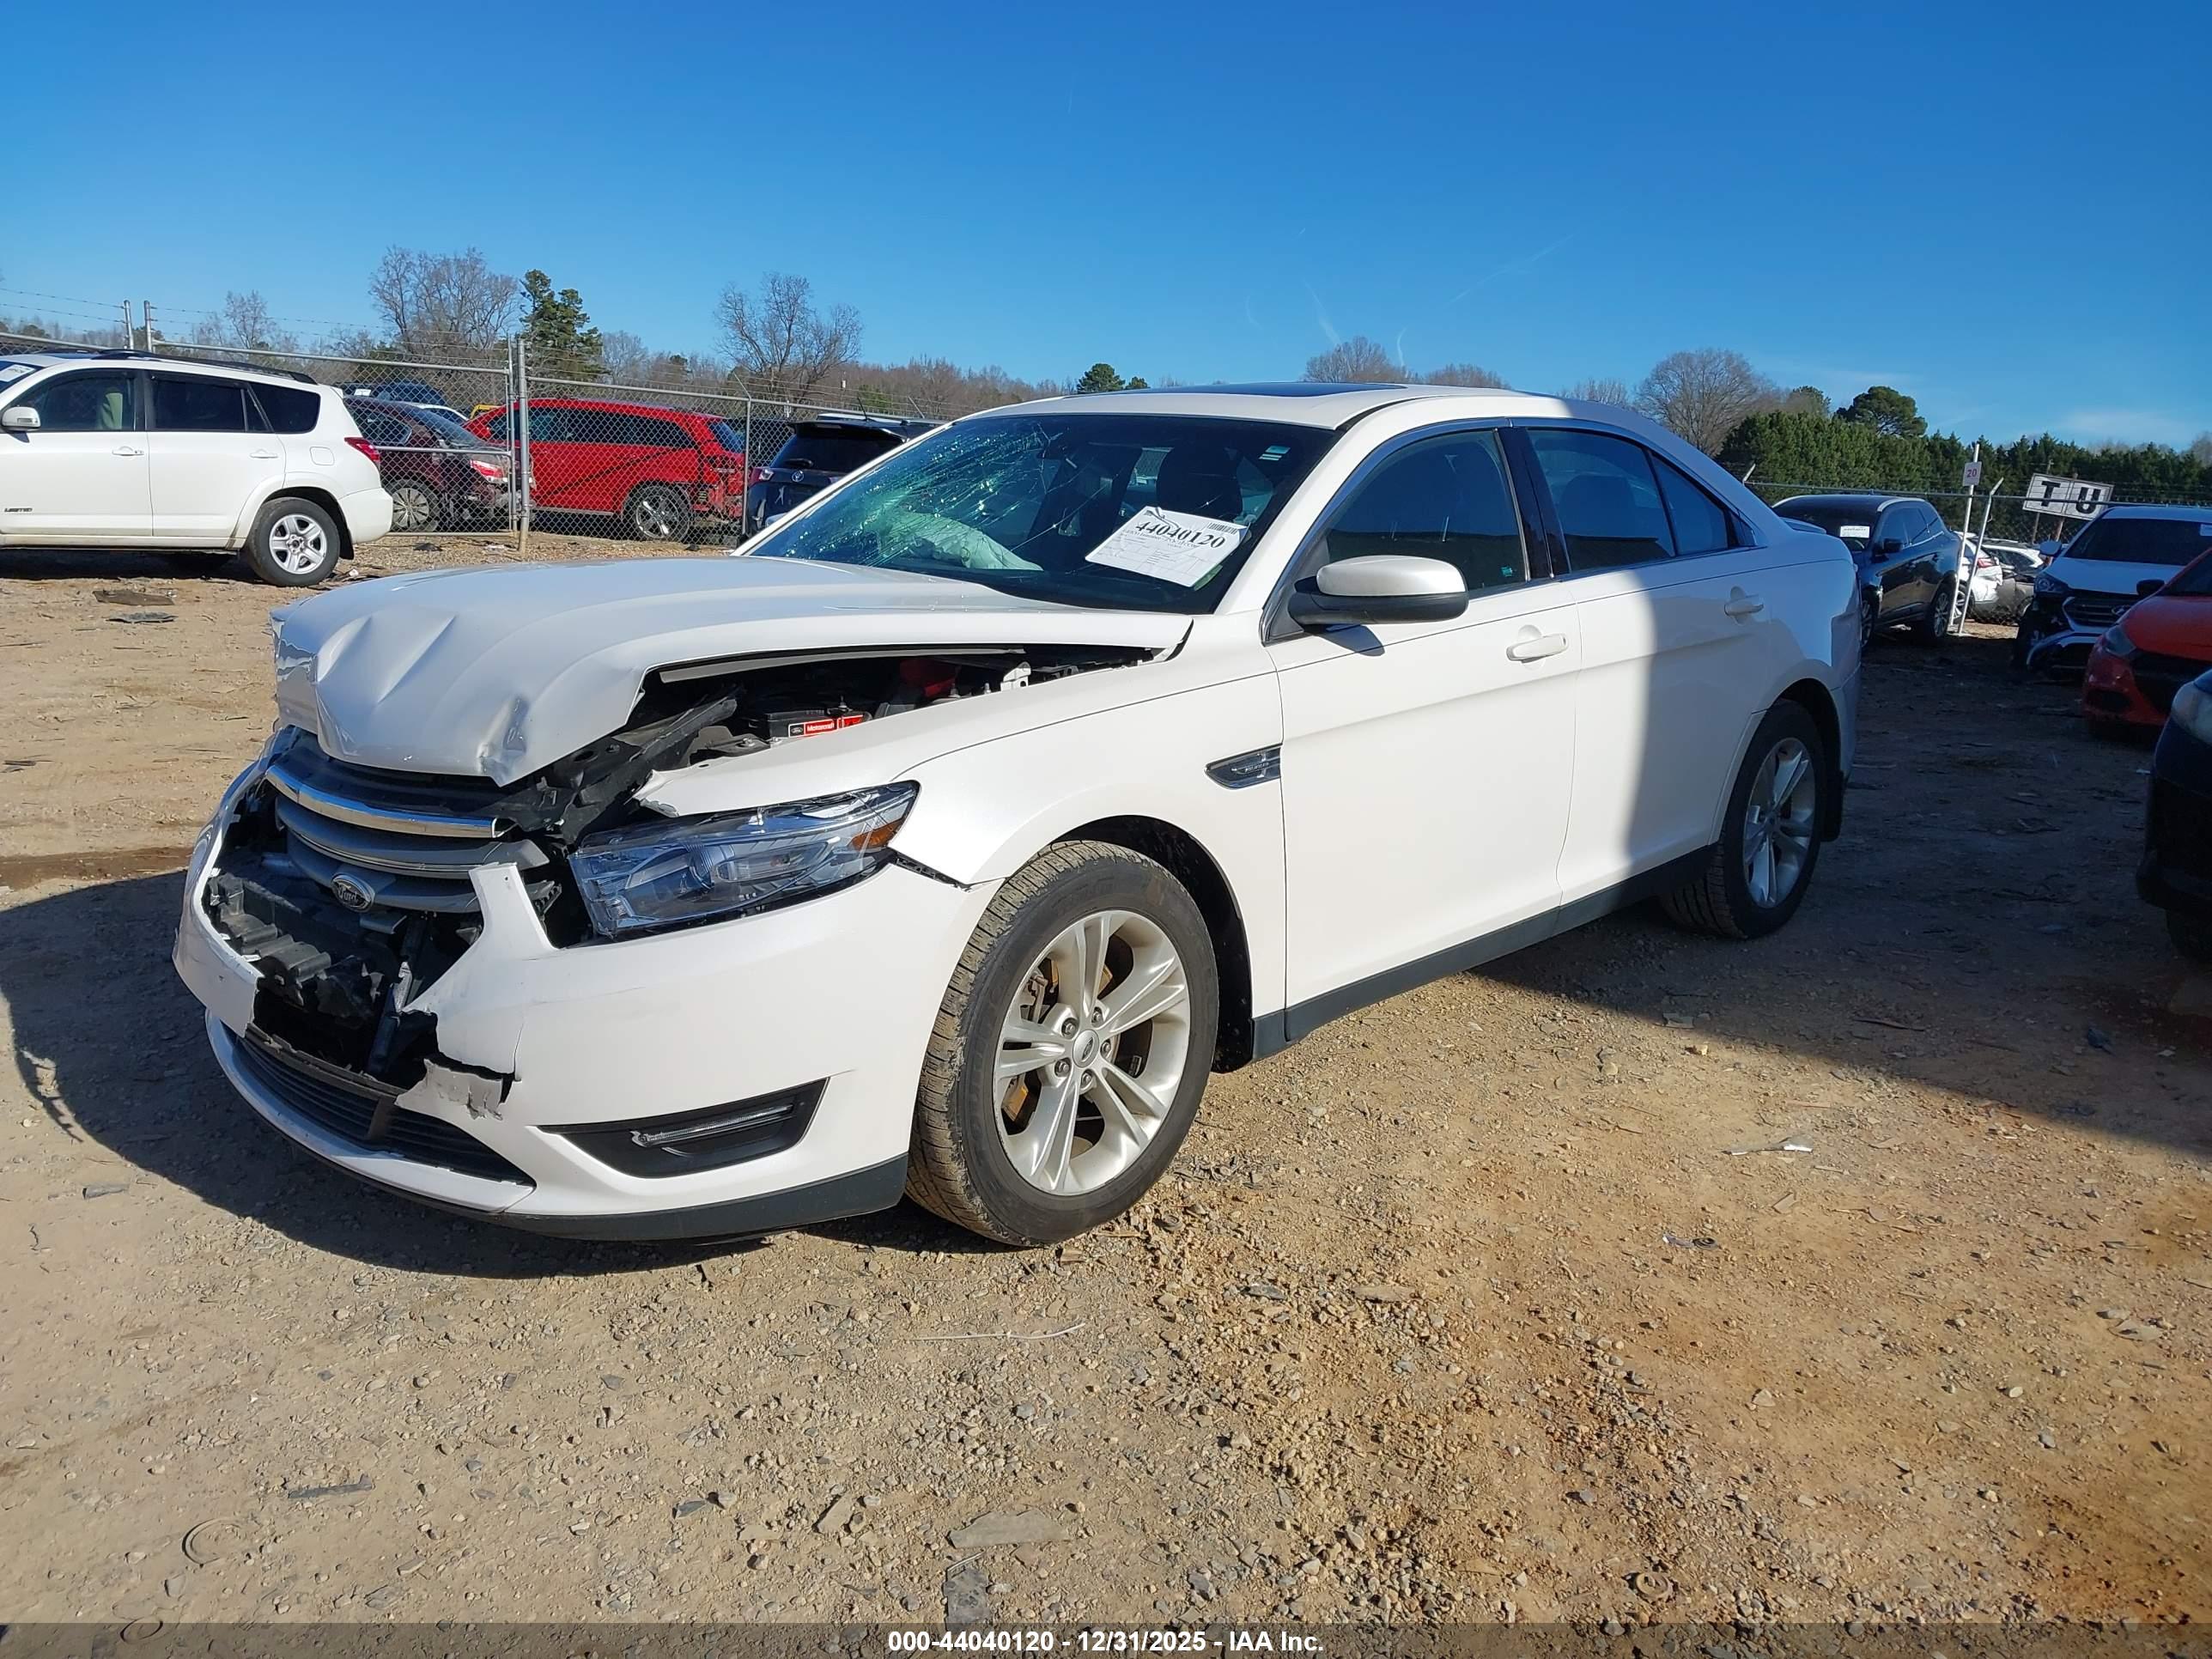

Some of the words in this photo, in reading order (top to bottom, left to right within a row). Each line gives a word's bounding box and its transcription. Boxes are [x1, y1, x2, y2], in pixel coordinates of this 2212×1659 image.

[1966, 468, 1978, 477] 20
[2041, 481, 2061, 507] T
[2075, 487, 2101, 514] U
[1135, 521, 1226, 549] 44040120
